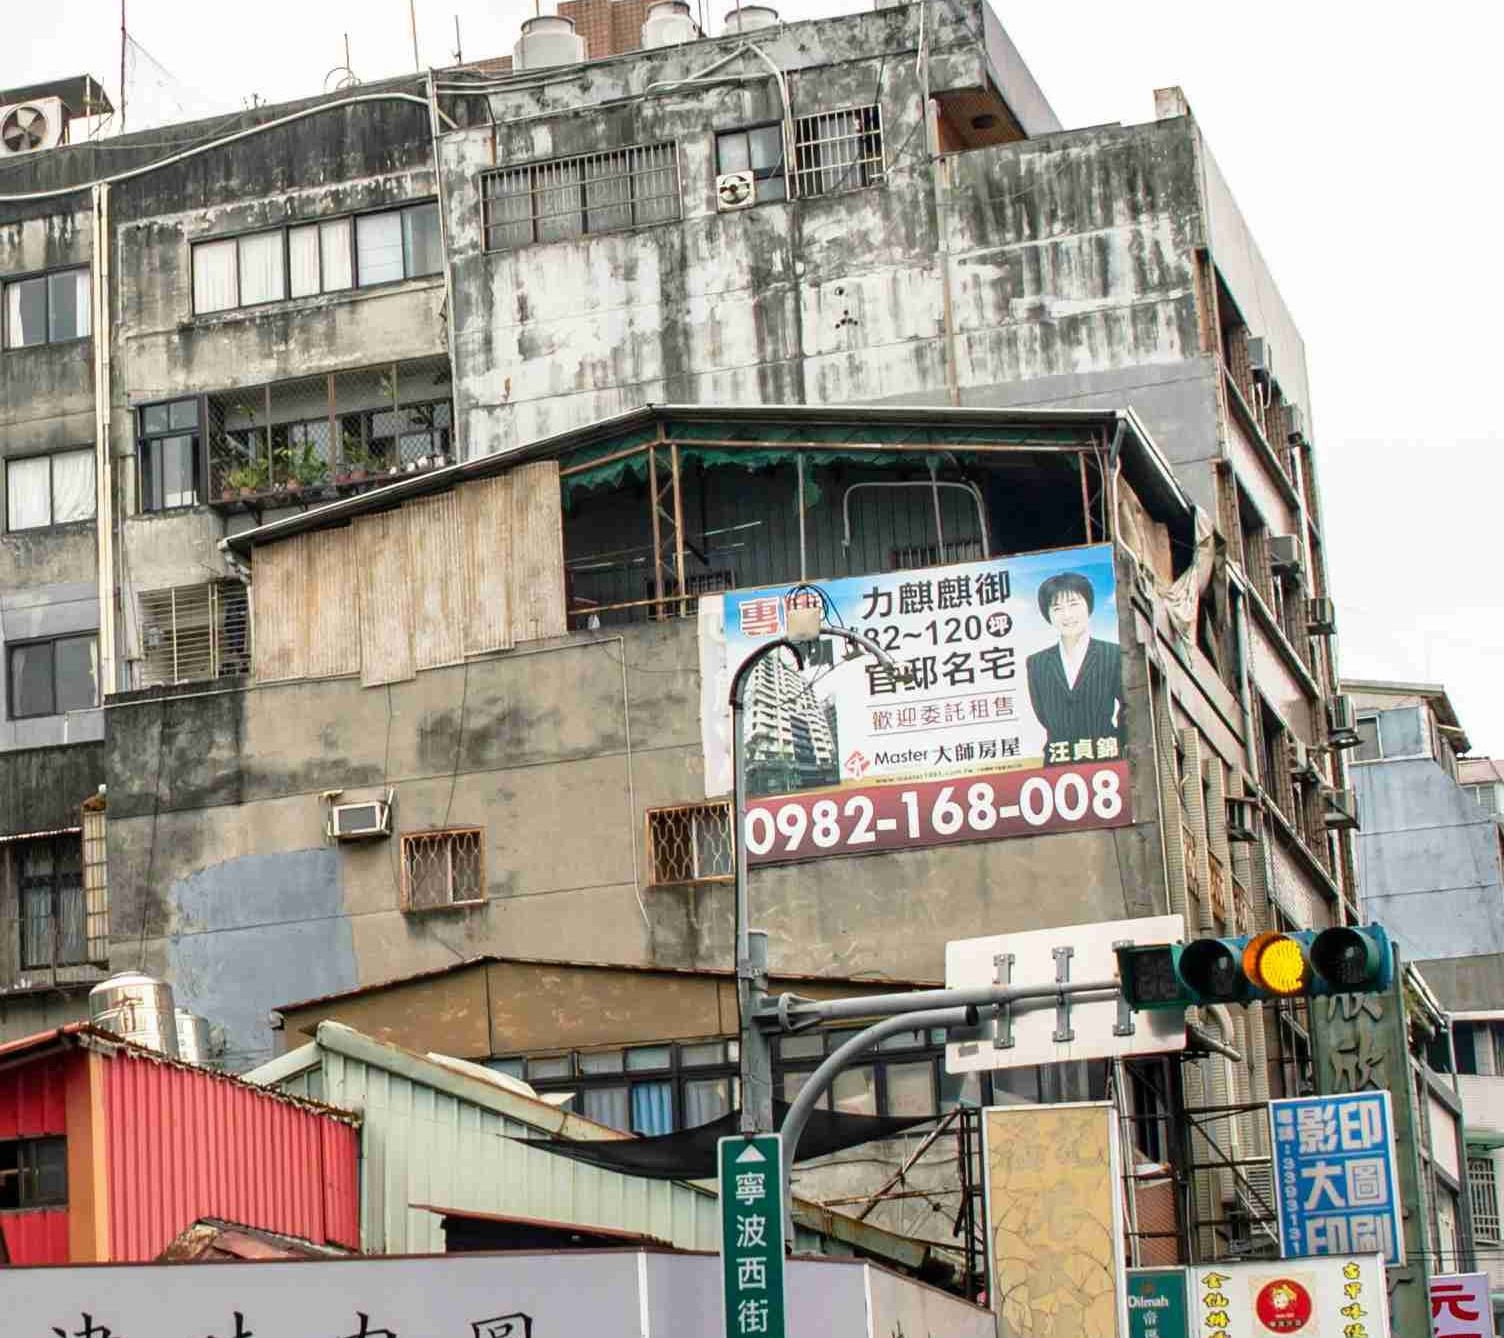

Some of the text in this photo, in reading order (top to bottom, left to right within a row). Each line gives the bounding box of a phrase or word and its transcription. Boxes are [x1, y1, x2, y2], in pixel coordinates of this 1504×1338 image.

[862, 571, 1011, 620] 力麒麒御
[865, 646, 1016, 696] 官邸名宅
[871, 696, 1015, 731] 歡迎委託租售
[874, 736, 1022, 766] Master 大師房屋
[744, 769, 1122, 856] 0982-168-008
[1296, 1099, 1382, 1154] 影印
[1301, 1157, 1389, 1212] 大圖
[734, 1171, 768, 1336] 寧波西街
[1306, 1212, 1394, 1261] 印刷
